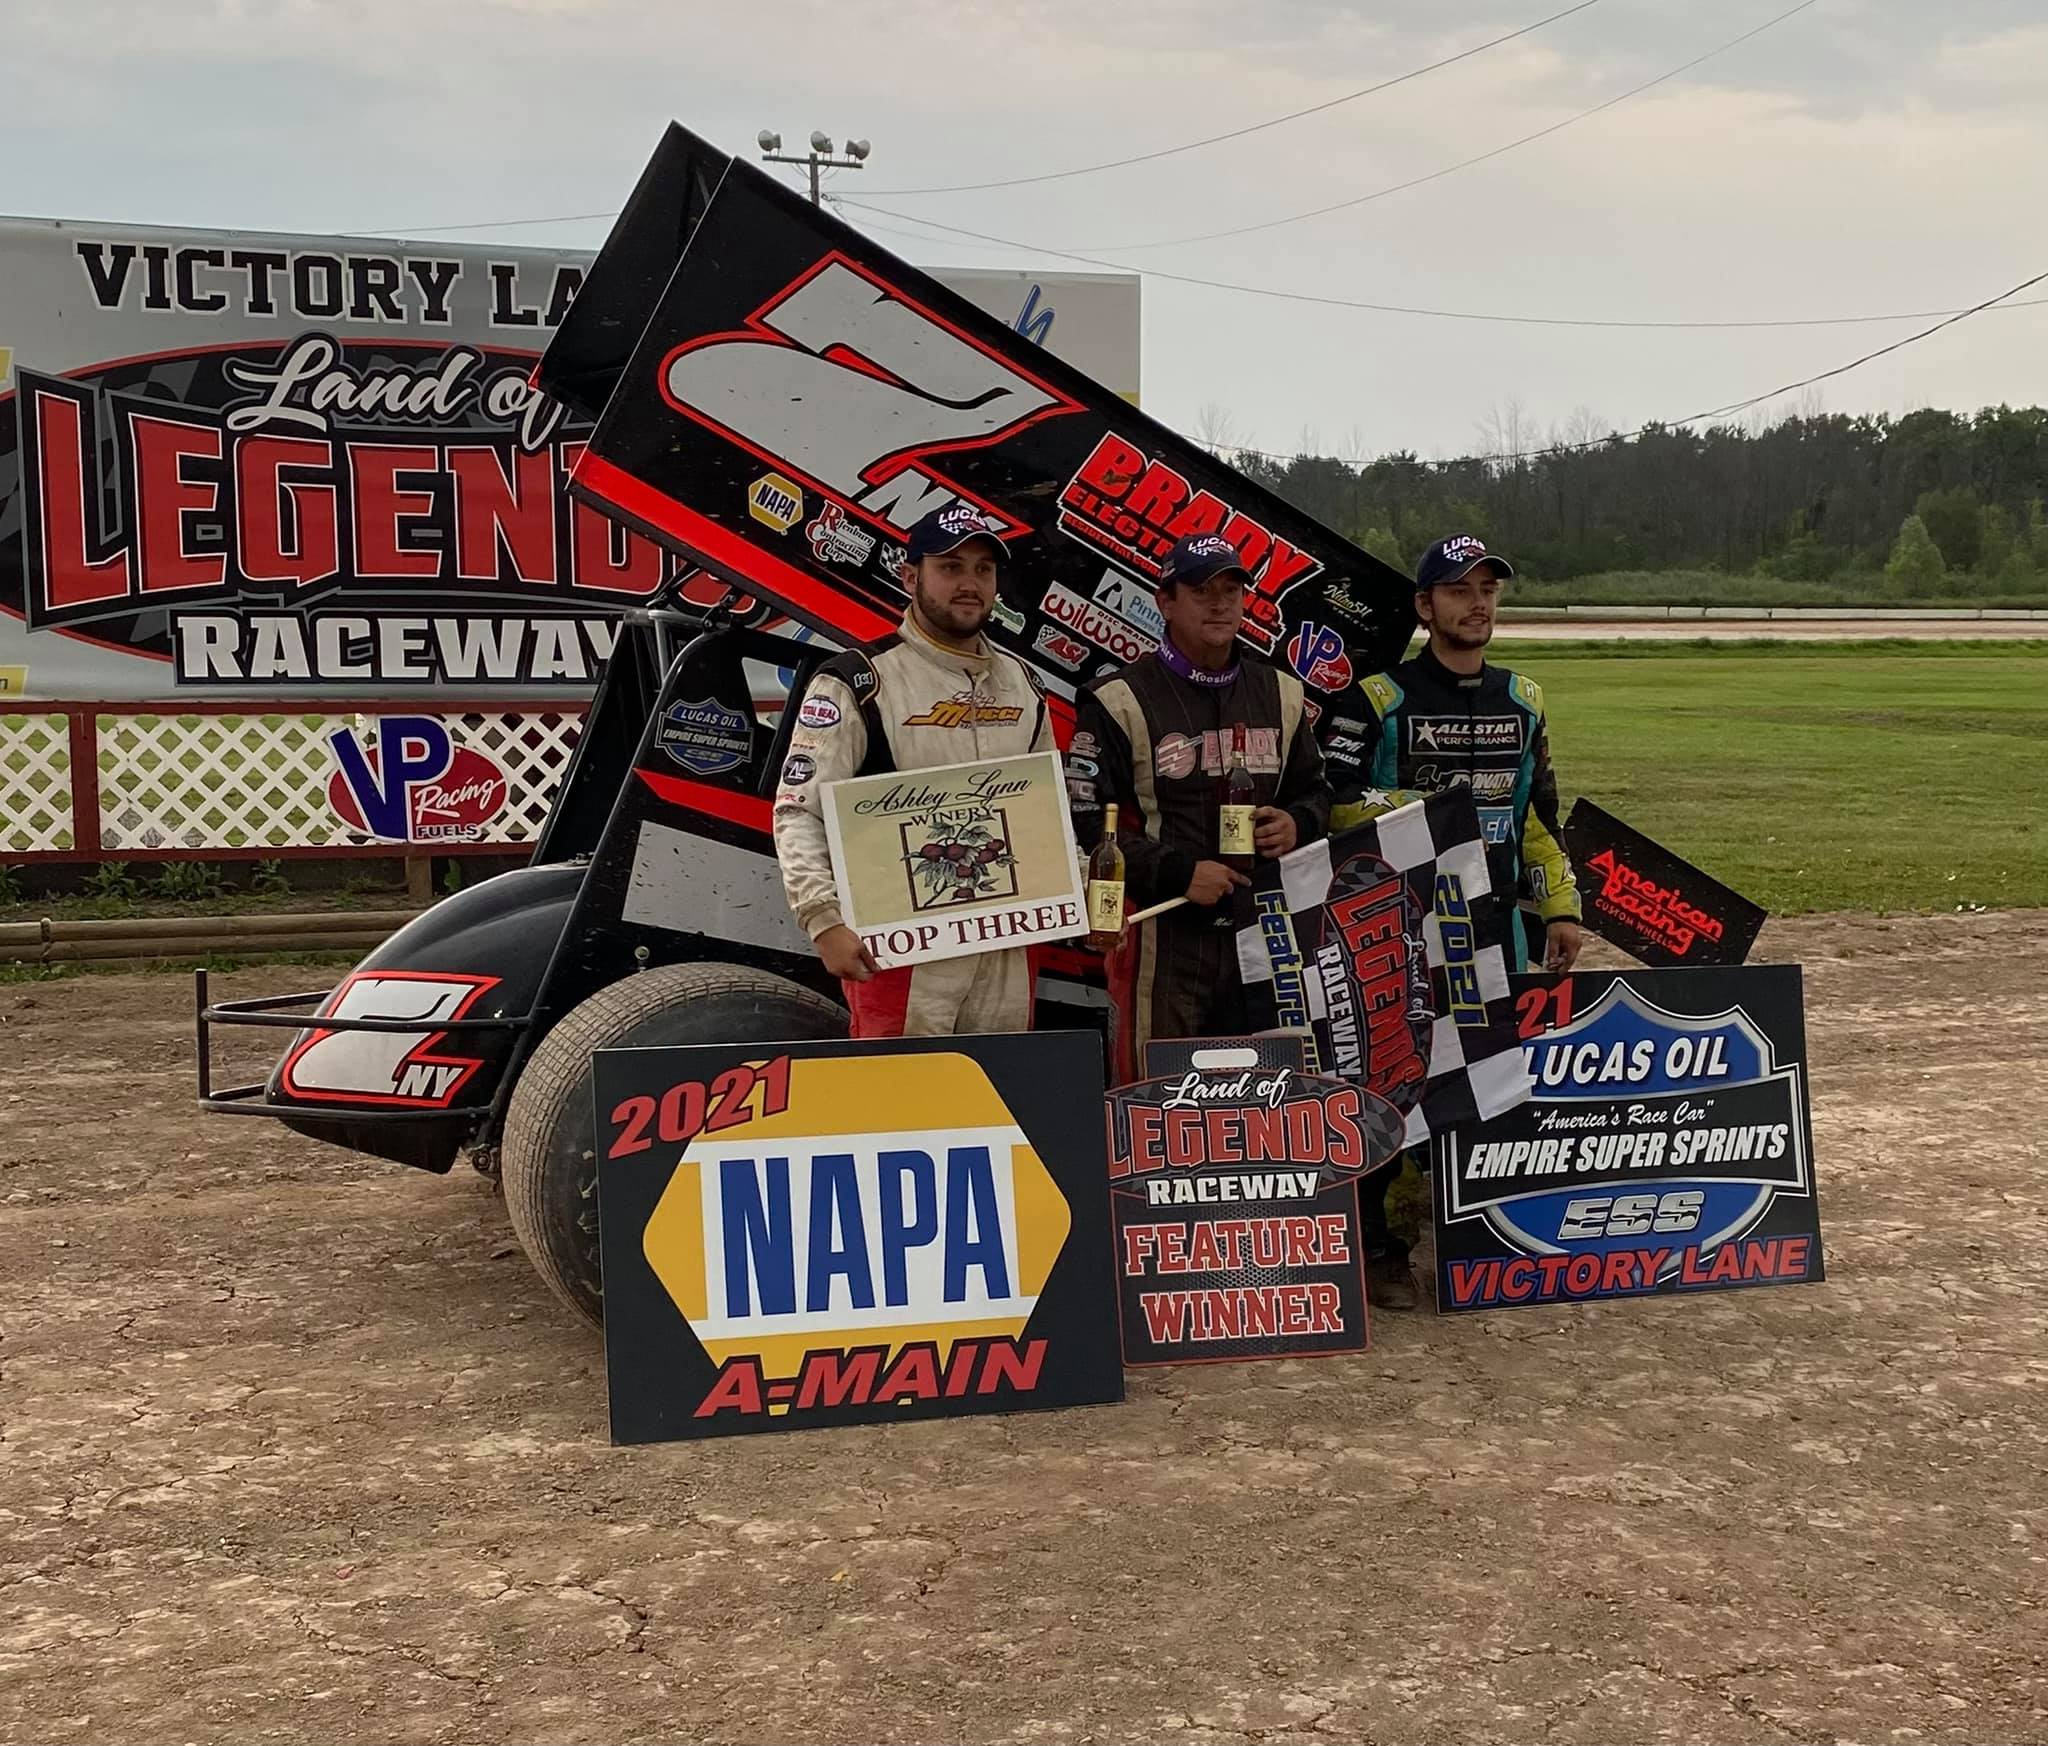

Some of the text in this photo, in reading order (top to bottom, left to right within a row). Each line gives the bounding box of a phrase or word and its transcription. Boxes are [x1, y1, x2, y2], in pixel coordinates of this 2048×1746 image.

[76, 242, 584, 327] VICTORY LA
[227, 338, 475, 431] Land
[662, 255, 1072, 500] 7
[35, 390, 757, 613] LEGEND
[755, 483, 797, 521] NAPA
[1063, 484, 1175, 557] ELECTR
[1076, 431, 1322, 597] BRADY
[1044, 593, 1140, 661] wilwoo
[1097, 611, 1121, 627] DISC
[1297, 622, 1343, 679] VP
[663, 728, 693, 741] EMPIRE
[691, 733, 718, 746] SUPER
[716, 738, 749, 752] SPRINTS
[680, 709, 738, 728] LUCAS OIL
[1436, 723, 1517, 735] ALL STAR
[329, 715, 454, 841] VP
[413, 776, 505, 824] Racing
[854, 769, 1033, 815] Ashley Lynn
[416, 823, 478, 838] FUELS
[911, 804, 996, 828] WINERY
[1588, 849, 1724, 939] American
[1595, 898, 1673, 949] CUSTOM WHEELS
[1600, 877, 1694, 956] Racing
[861, 901, 1082, 959] TOP THREE
[1317, 944, 1363, 1078] RACEWAY
[1328, 877, 1428, 1099] LEGENDS
[1514, 978, 1574, 1039] 21
[288, 975, 482, 1095] 7
[1524, 1035, 1729, 1088] LUCAS OIL
[398, 1064, 464, 1098] NY
[607, 1055, 791, 1160] 2021
[1162, 1068, 1293, 1110] Land of
[1105, 1089, 1364, 1180] LEGENDS
[1626, 1104, 1669, 1126] Race
[1465, 1123, 1789, 1180] EMPIRE SUPER SPRINTS
[1147, 1171, 1319, 1205] RACEWAY
[1557, 1190, 1705, 1240] ESS
[718, 1145, 1012, 1320] NAPA
[1123, 1213, 1350, 1277] FEATURE
[1449, 1235, 1812, 1304] VICTORY LANE
[1139, 1282, 1345, 1344] WINNER
[693, 1338, 1049, 1418] A-MAIN
